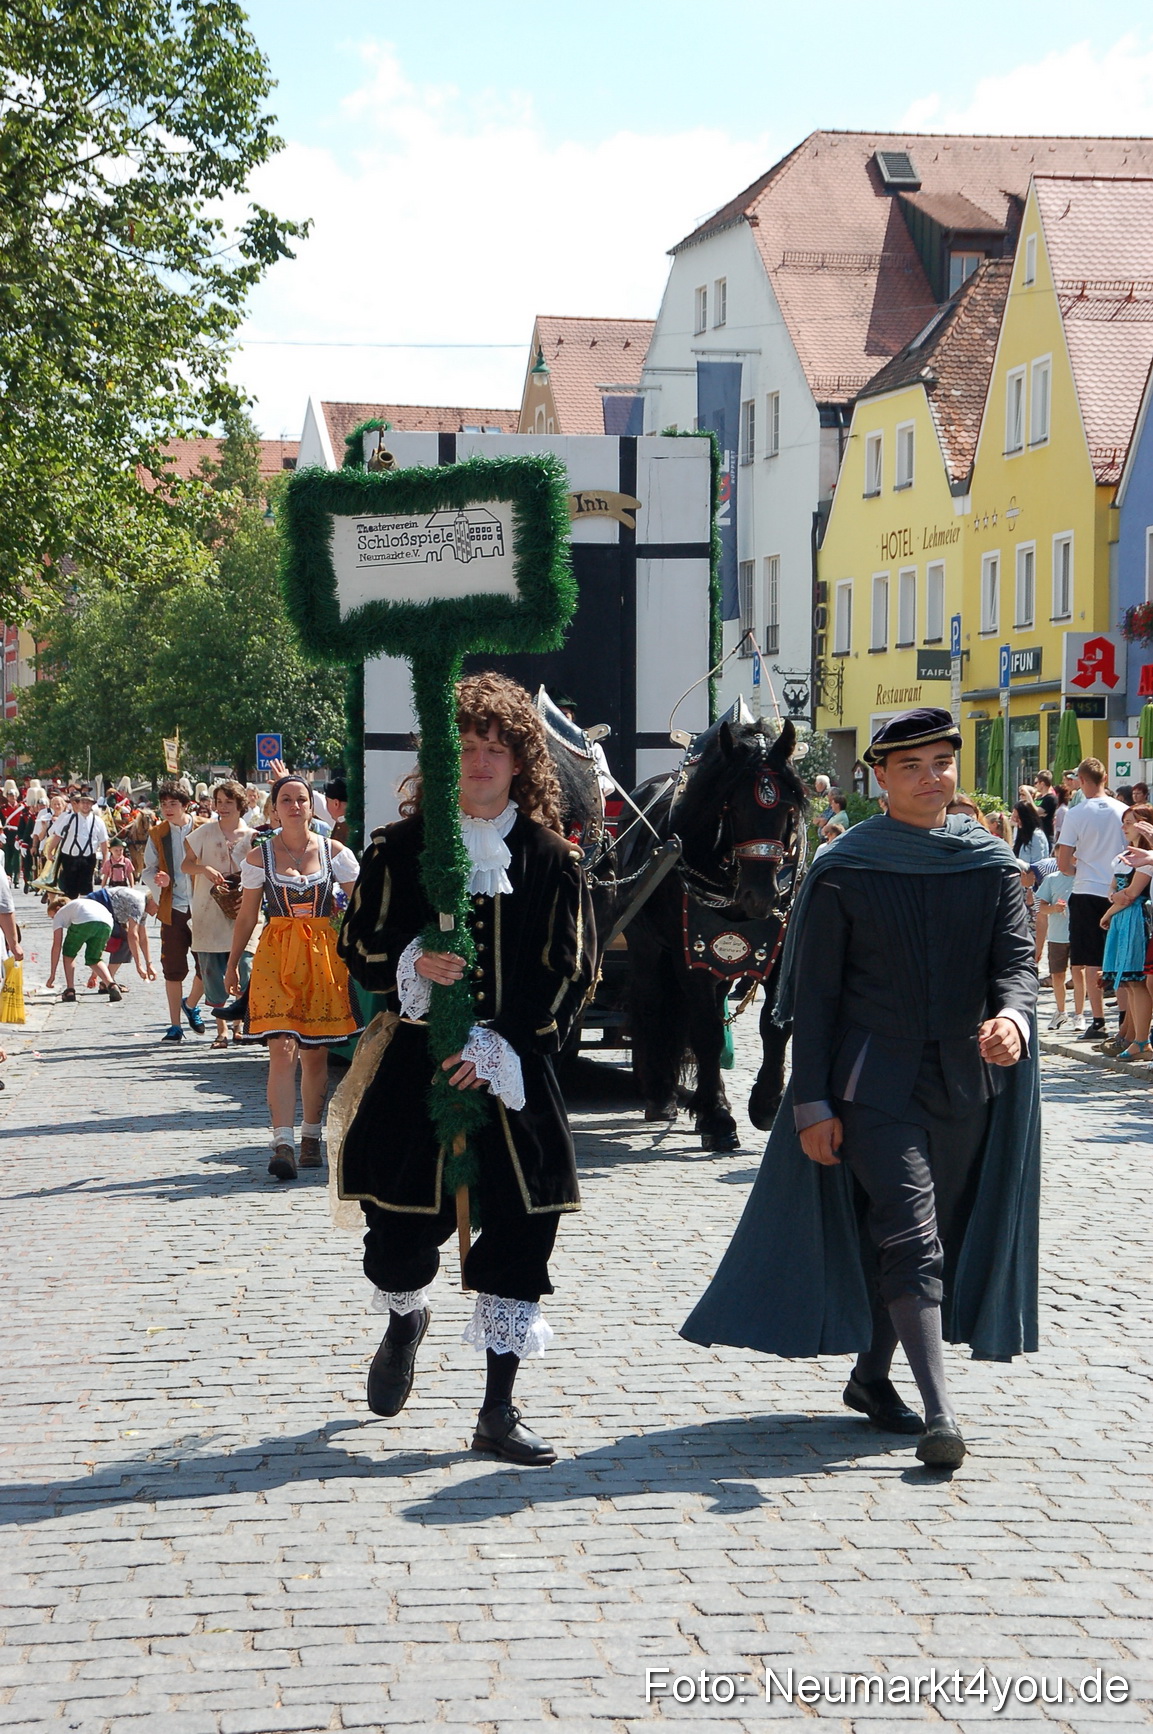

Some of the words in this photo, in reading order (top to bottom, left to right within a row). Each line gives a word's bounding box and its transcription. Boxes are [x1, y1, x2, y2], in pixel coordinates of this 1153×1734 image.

[573, 493, 609, 513] Inn
[356, 520, 419, 534] Theaterverein
[357, 528, 455, 550] Schloßspiele
[881, 527, 914, 561] HOTEL
[922, 522, 961, 550] Lehmeier
[359, 551, 404, 562] Neumarkt
[405, 549, 421, 558] e.V.
[1001, 651, 1008, 684] P
[1010, 652, 1034, 672] IFUN
[920, 668, 951, 677] TAIFU
[876, 684, 922, 705] Restaurant
